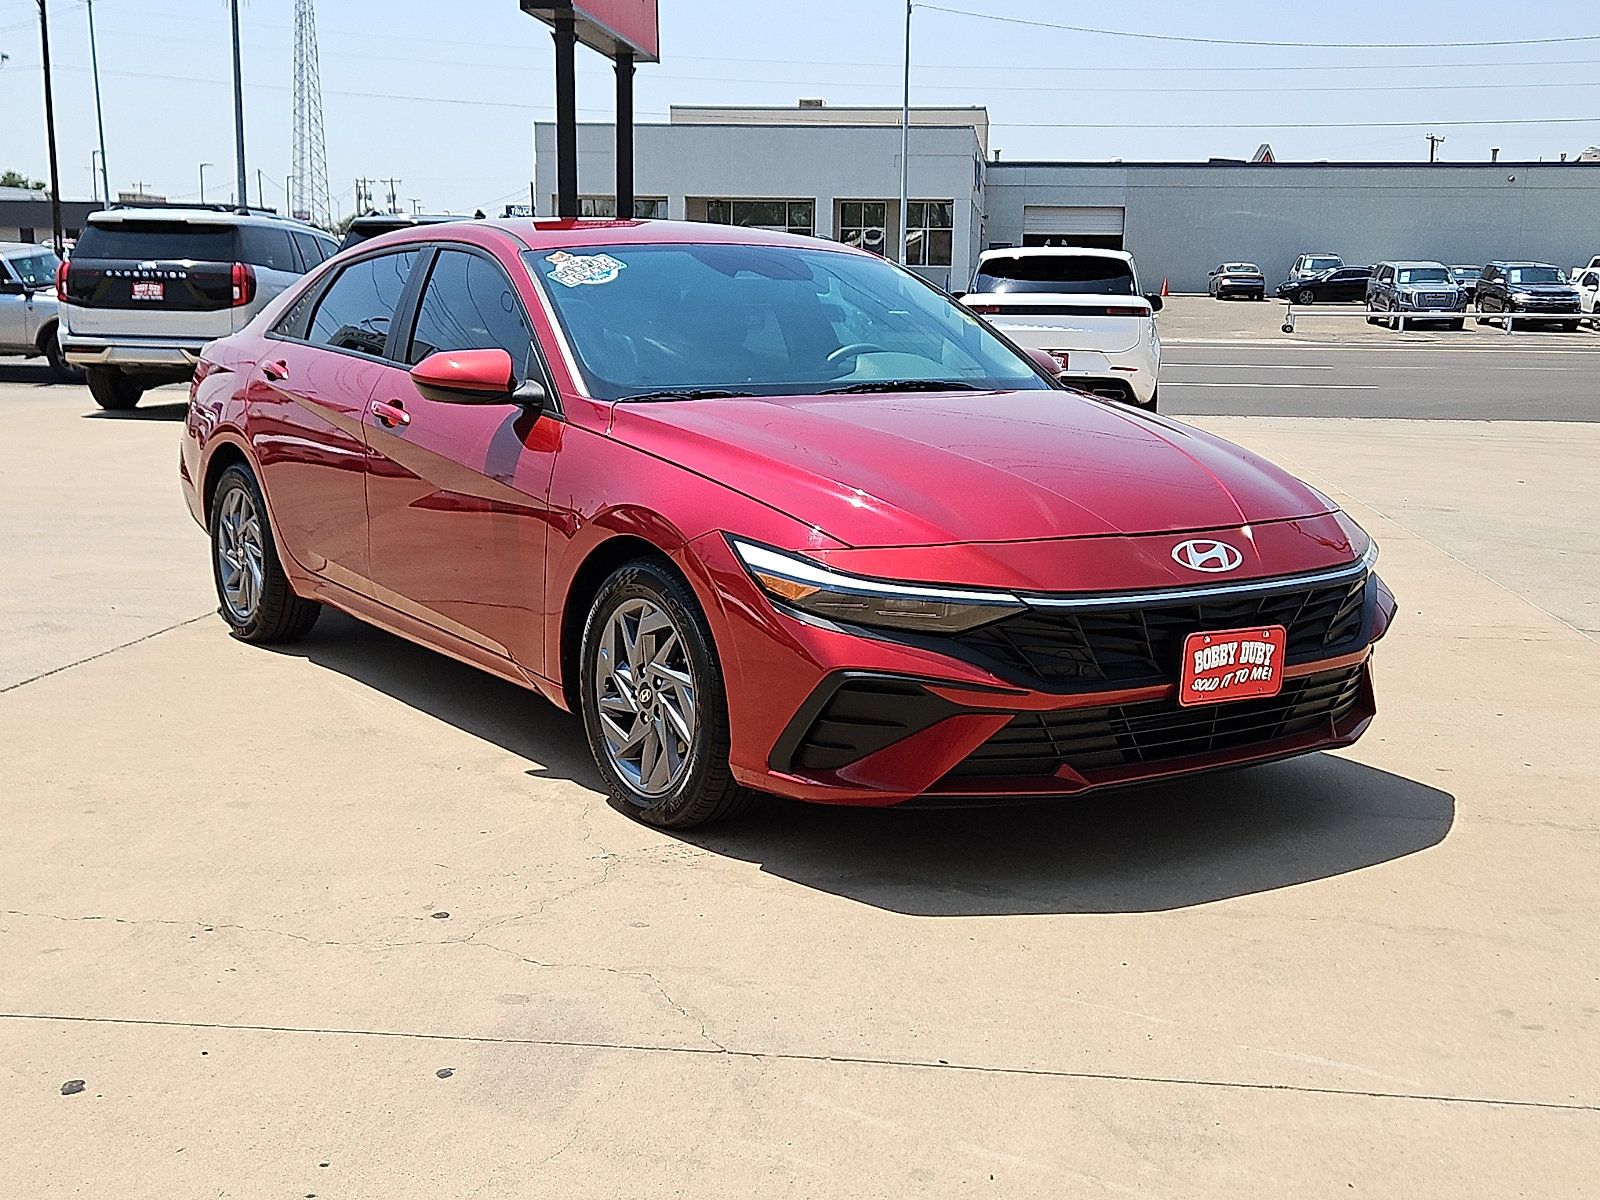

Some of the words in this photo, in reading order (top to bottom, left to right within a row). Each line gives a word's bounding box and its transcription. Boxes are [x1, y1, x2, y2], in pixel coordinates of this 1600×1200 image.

[106, 270, 187, 278] EXPEDITION
[1194, 642, 1238, 674] BOBBY
[1240, 641, 1276, 665] DUBY
[1191, 679, 1219, 691] SOLD
[1220, 673, 1234, 688] IT
[1235, 668, 1249, 684] TO
[1250, 666, 1272, 681] ME!
